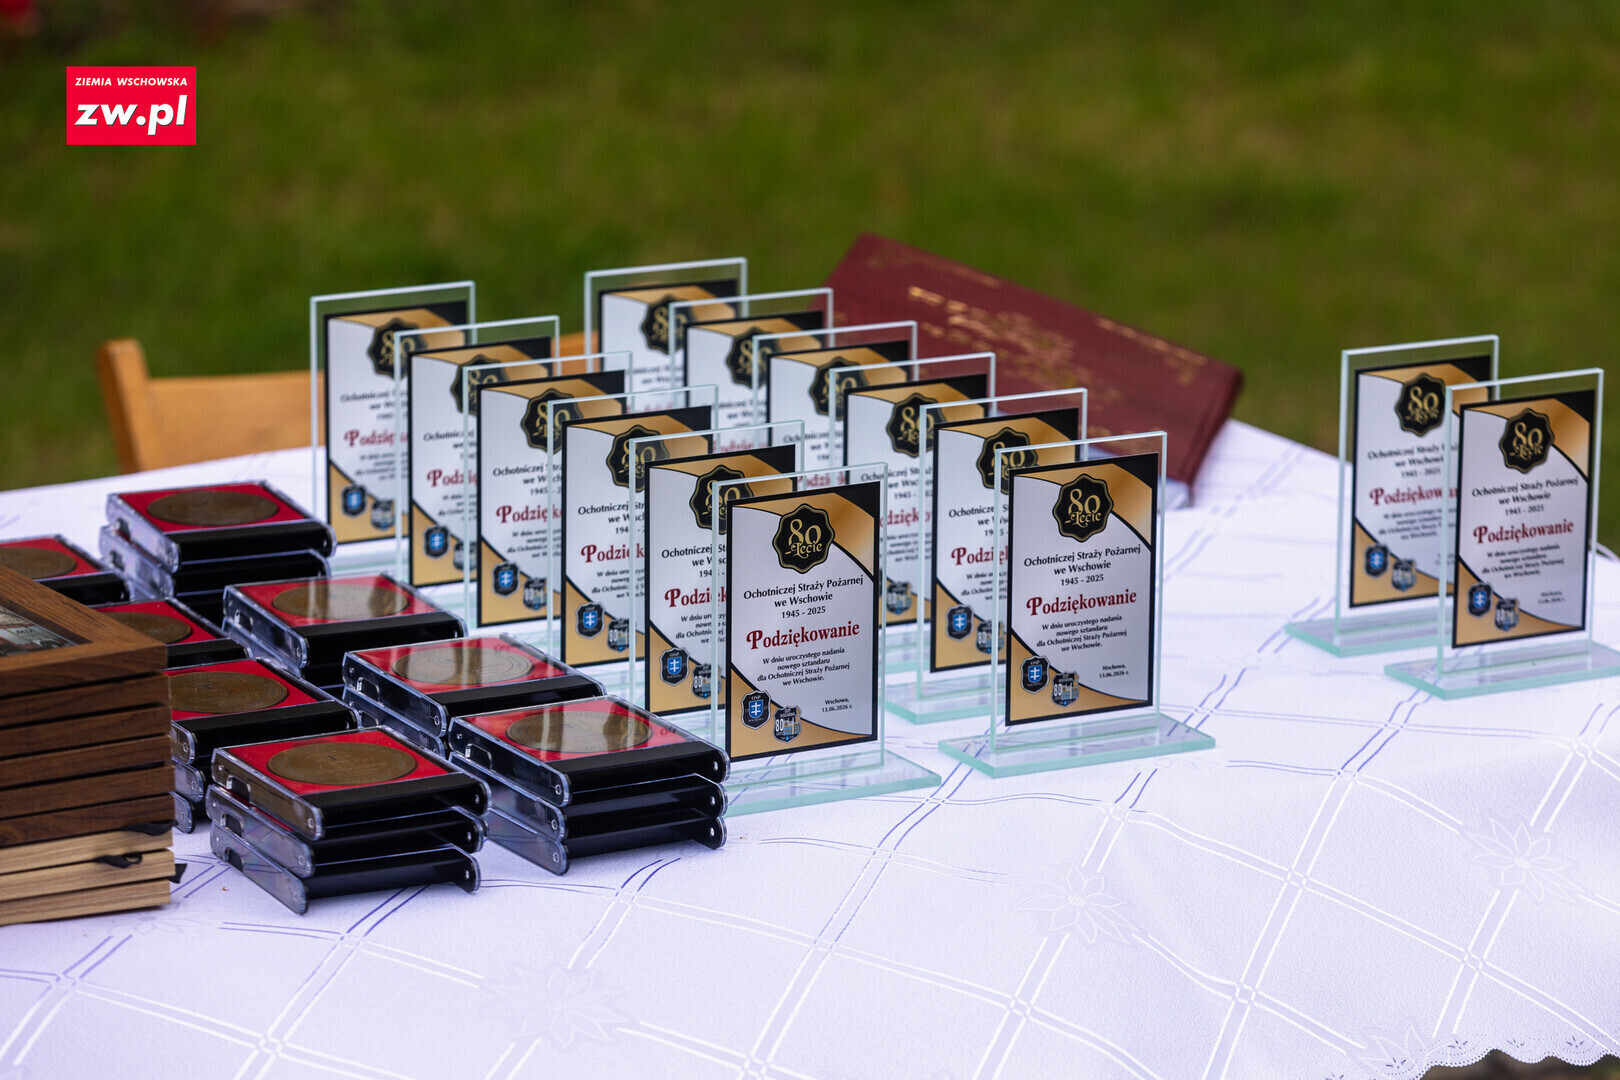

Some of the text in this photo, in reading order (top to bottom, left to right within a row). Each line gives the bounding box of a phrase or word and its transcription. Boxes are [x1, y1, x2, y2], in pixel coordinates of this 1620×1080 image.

[1407, 386, 1439, 412] 80
[1512, 421, 1543, 448] 80
[492, 462, 544, 476] Ochotniczej
[578, 501, 629, 515] Ochotniczej
[1068, 488, 1101, 515] 80
[608, 515, 621, 523] we
[948, 504, 995, 518] Ochotnicze
[788, 518, 822, 546] 80
[1472, 518, 1574, 544] Podziękowanie
[661, 544, 713, 558] Ochotniczej
[1024, 544, 1141, 567] Ochotniczej Straży Pożarnej
[692, 559, 705, 567] we
[1053, 560, 1112, 575] we Wschowie
[743, 575, 864, 600] Ochotniczej Straży Pożarnej
[1060, 577, 1079, 586] 1945
[1085, 574, 1104, 583] 2025
[774, 592, 833, 608] we Wschowie
[1026, 588, 1137, 616] Podziękowanie
[689, 614, 702, 622] dniu
[781, 609, 800, 619] 1945
[807, 606, 826, 616] 2025
[1050, 621, 1063, 630] dniu
[1064, 618, 1099, 628] uroczystego
[1099, 614, 1122, 623] nadania
[746, 621, 860, 650] Podziękowanie
[1036, 629, 1127, 648] dla Ochotniczej Straży Pożarnej
[1056, 624, 1108, 637] nowego sztandaru
[762, 647, 845, 665] W dniu uroczystego nadania
[777, 657, 830, 671] nowego sztandaru
[757, 662, 850, 682] dla Ochotniczej Straży Pożarnej
[792, 675, 825, 685] Wschowie.
